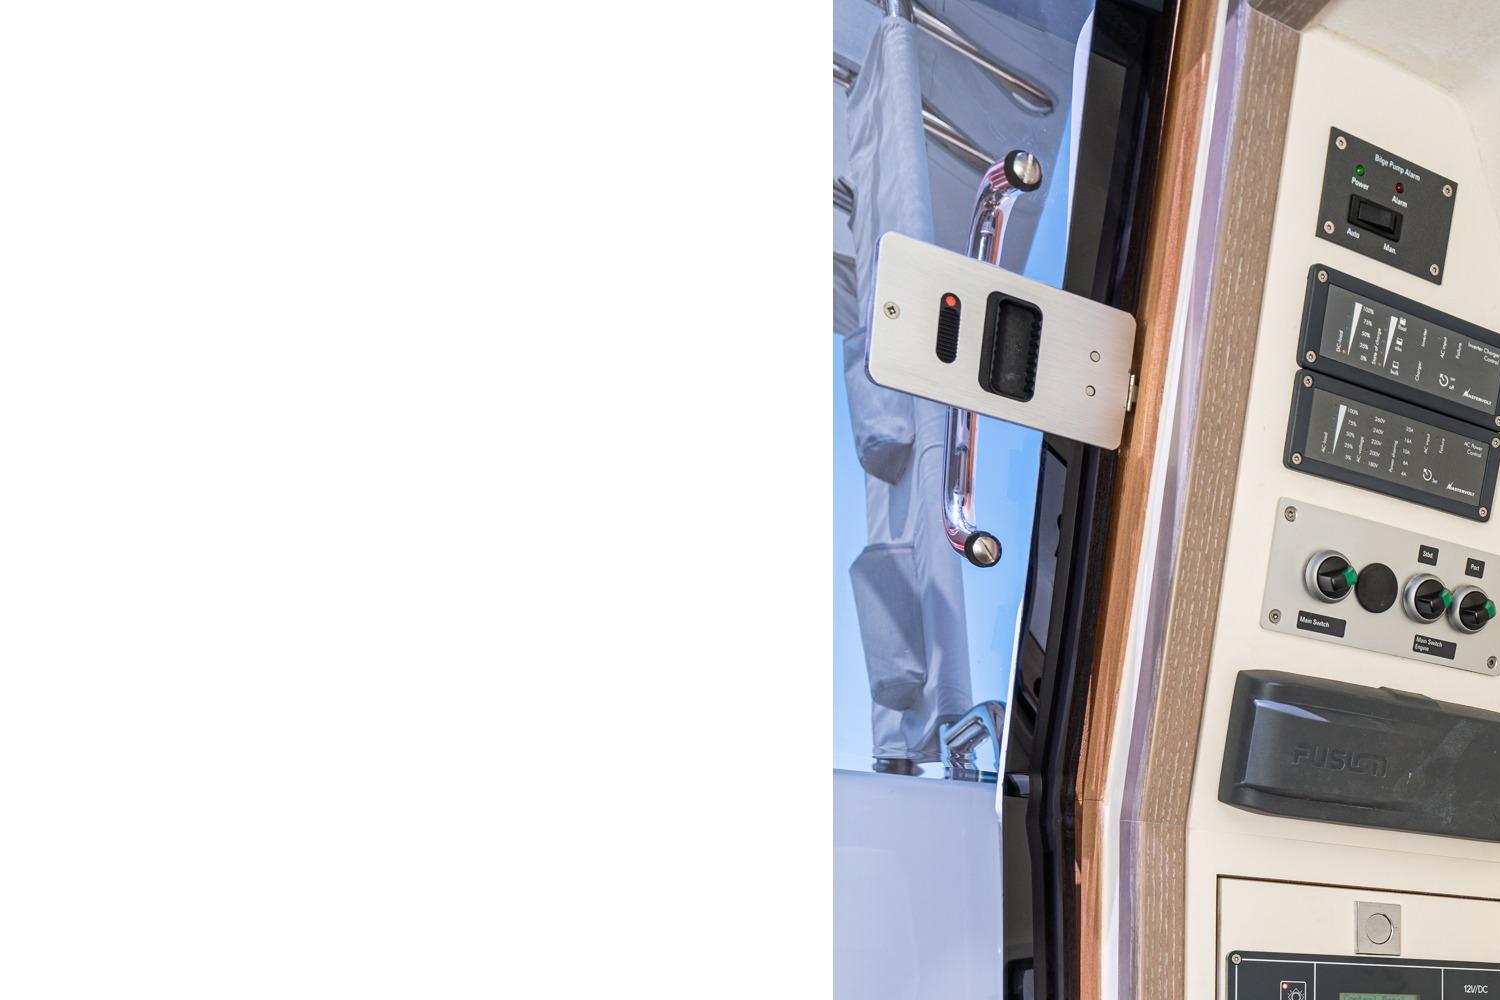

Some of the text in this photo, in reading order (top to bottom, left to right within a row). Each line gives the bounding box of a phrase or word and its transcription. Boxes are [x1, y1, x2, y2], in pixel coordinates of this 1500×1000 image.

[1374, 154, 1420, 181] Bilge Pump Alarm
[1351, 176, 1369, 190] Power
[1392, 195, 1408, 208] Alarm
[1346, 228, 1360, 239] Auto
[1467, 449, 1482, 458] Control
[1470, 563, 1480, 572] Port
[1300, 616, 1330, 628] Main Switch
[1414, 644, 1430, 652] Engine
[1416, 636, 1443, 648] Main Switch
